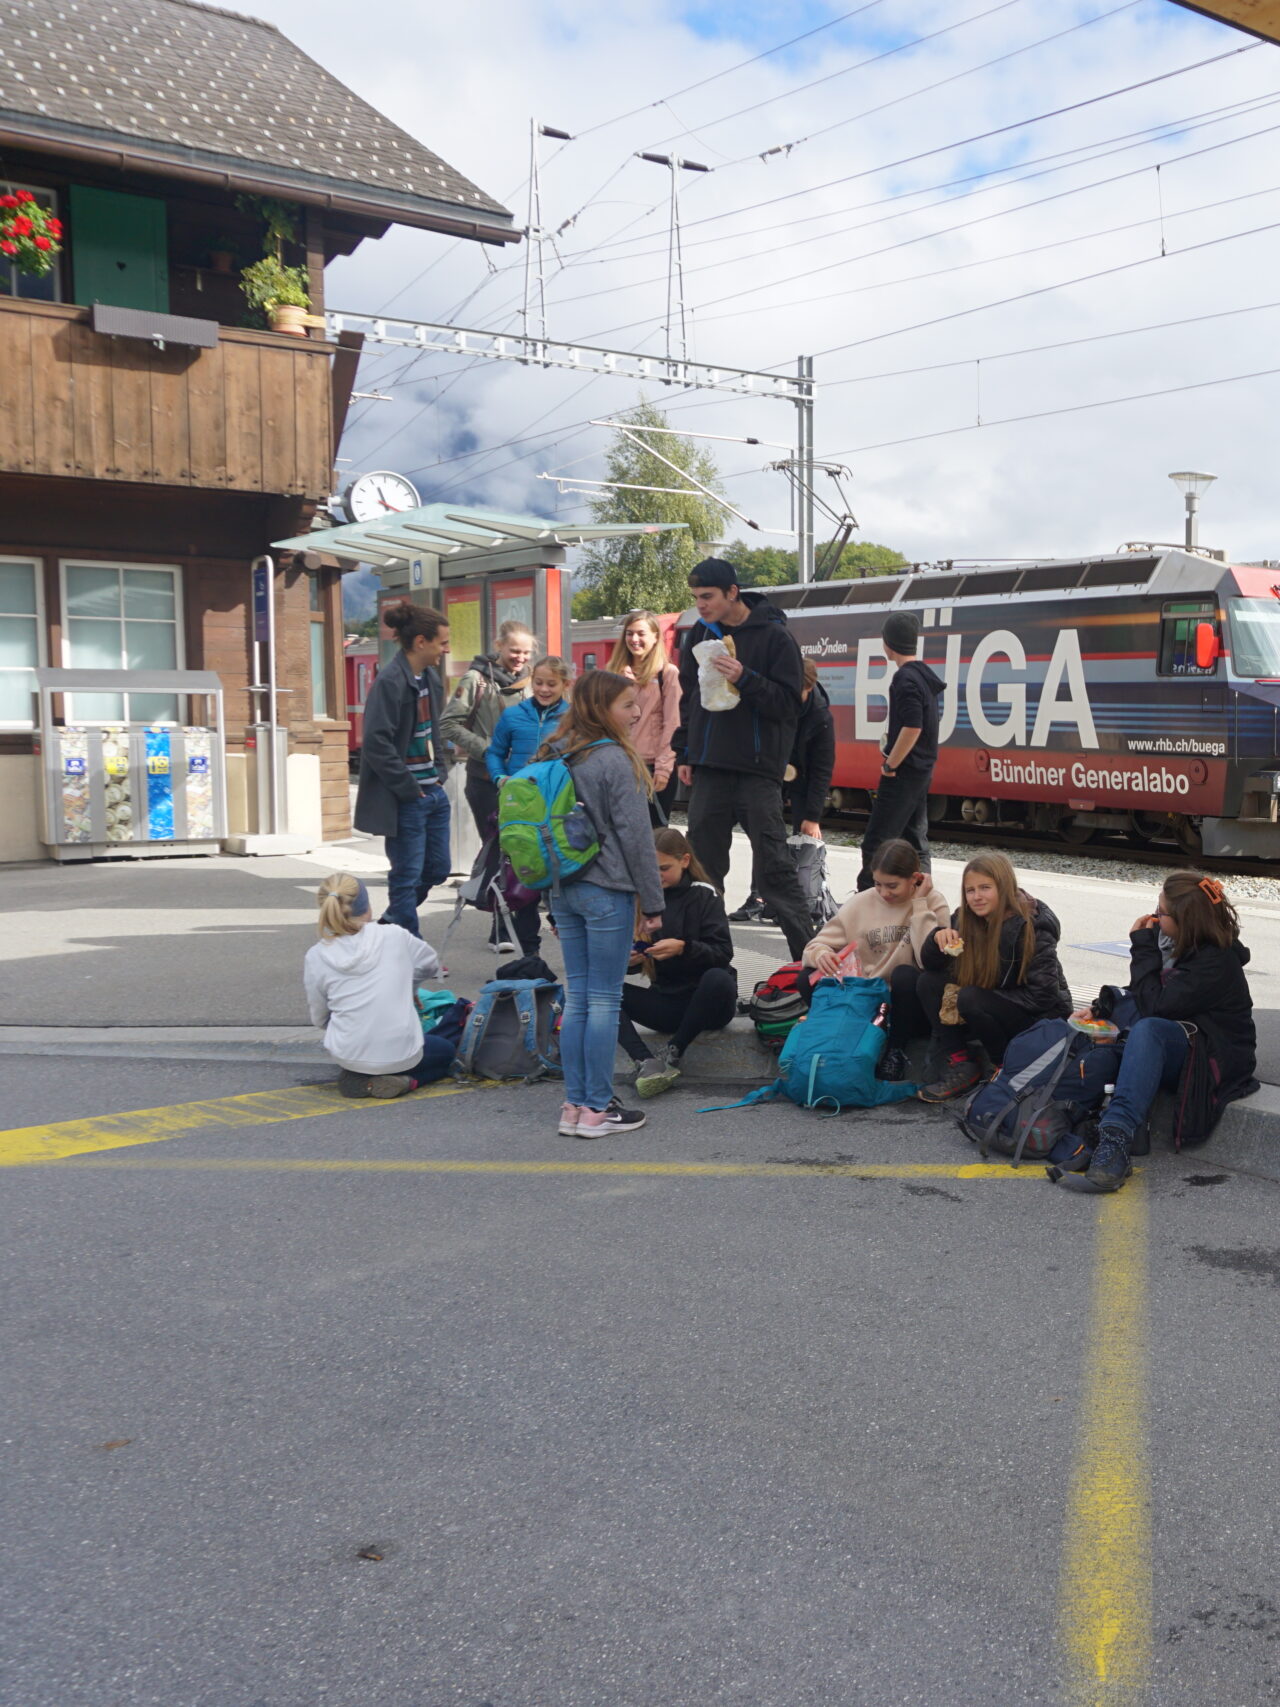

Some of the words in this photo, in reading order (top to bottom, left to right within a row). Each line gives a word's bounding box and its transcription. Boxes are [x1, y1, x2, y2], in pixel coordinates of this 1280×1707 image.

[855, 607, 1099, 750] BÜGA
[1127, 738, 1226, 756] www.rhb.ch/buega
[990, 758, 1066, 787] Bündner
[1071, 762, 1190, 795] Generalabo
